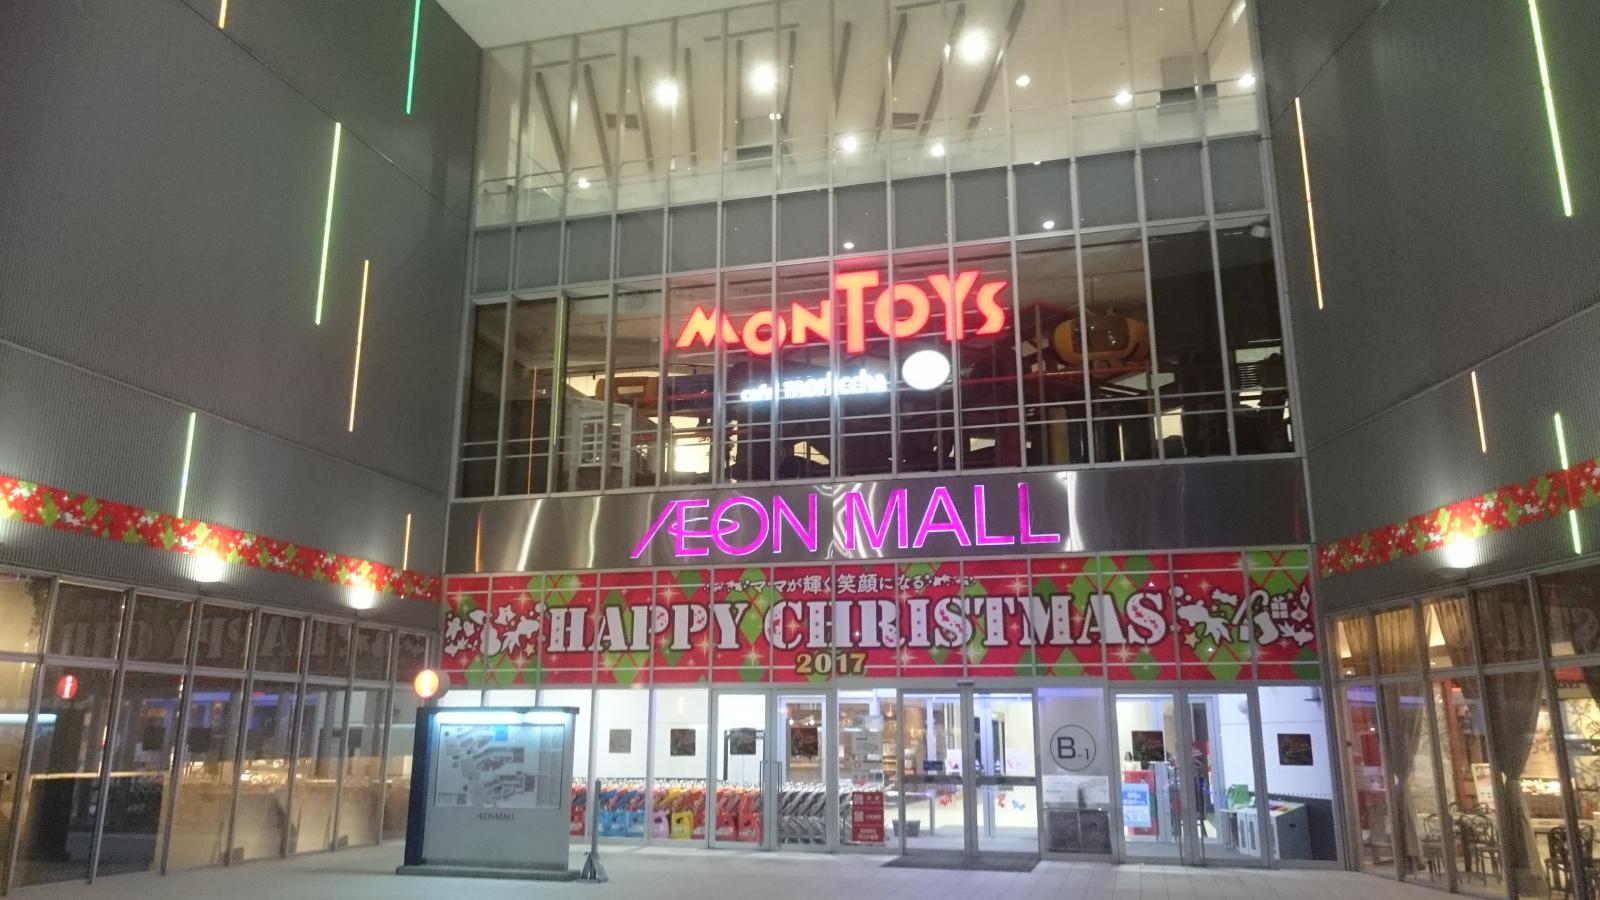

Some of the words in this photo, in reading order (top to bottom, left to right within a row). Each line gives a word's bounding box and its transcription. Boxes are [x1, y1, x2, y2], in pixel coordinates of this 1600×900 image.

[846, 482, 1060, 549] MALL
[546, 603, 750, 652] HAPPY
[764, 593, 1168, 649] CHRISTMAS
[795, 652, 866, 675] 2017
